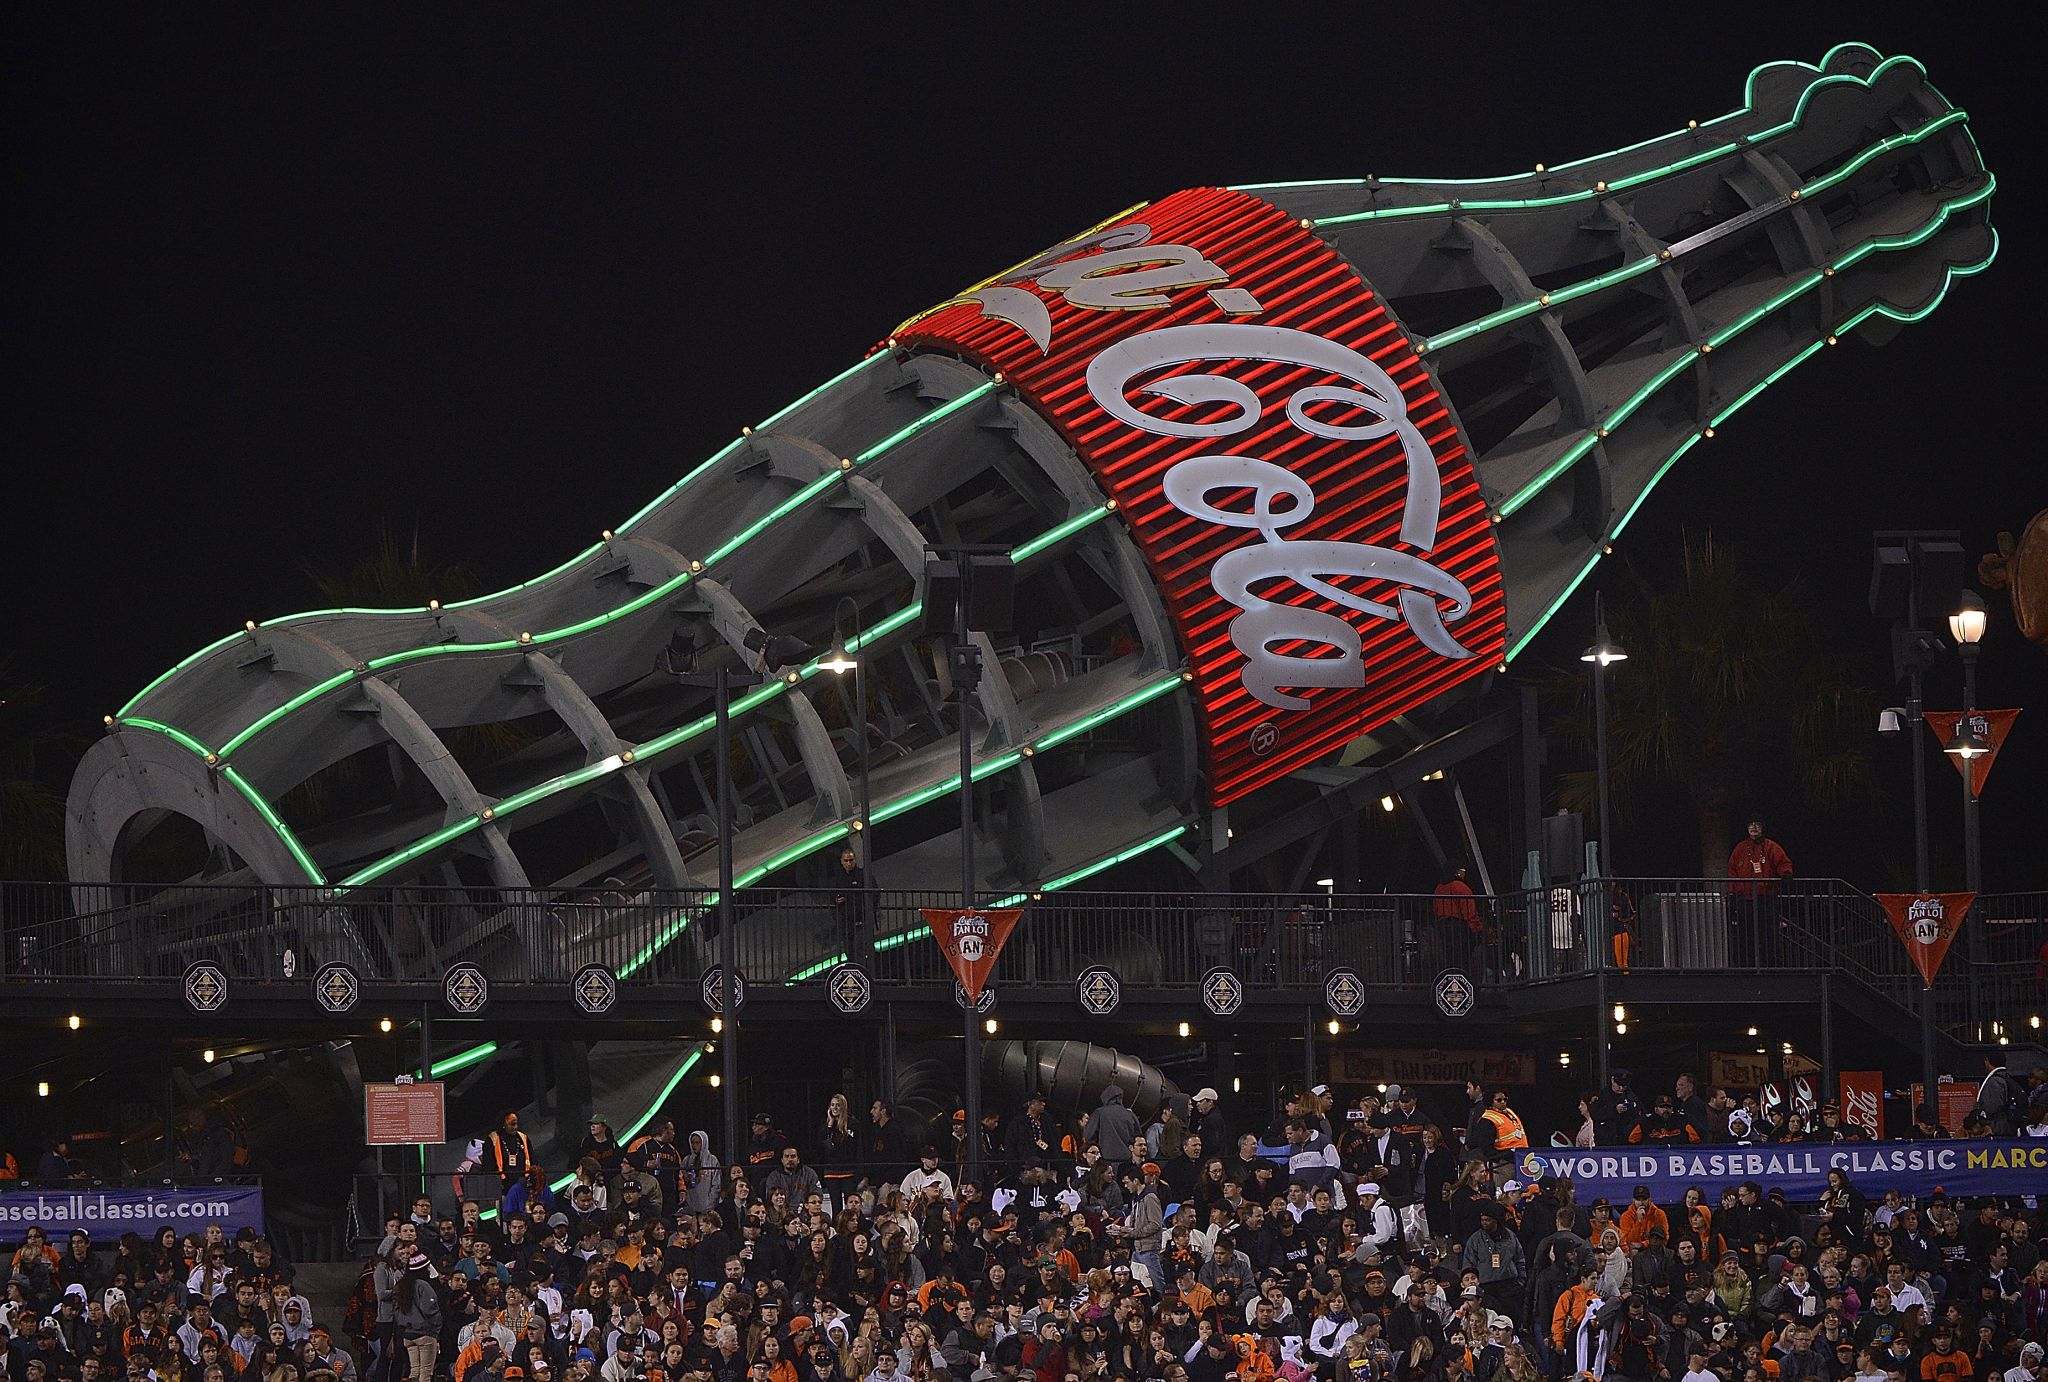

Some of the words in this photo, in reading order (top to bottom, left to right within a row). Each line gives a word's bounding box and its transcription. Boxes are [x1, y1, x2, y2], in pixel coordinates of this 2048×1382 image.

[1908, 906, 1925, 921] FAN
[1927, 906, 1944, 920] LOT
[953, 923, 971, 937] FAN
[972, 923, 989, 937] LOT
[1903, 925, 1952, 940] GIANTS
[947, 940, 996, 957] GIANTS
[1550, 1155, 1658, 1178] WORLD
[1669, 1153, 1820, 1177] BASEBALL
[1830, 1149, 1956, 1173] CLASSIC
[1967, 1147, 2048, 1170] MARC
